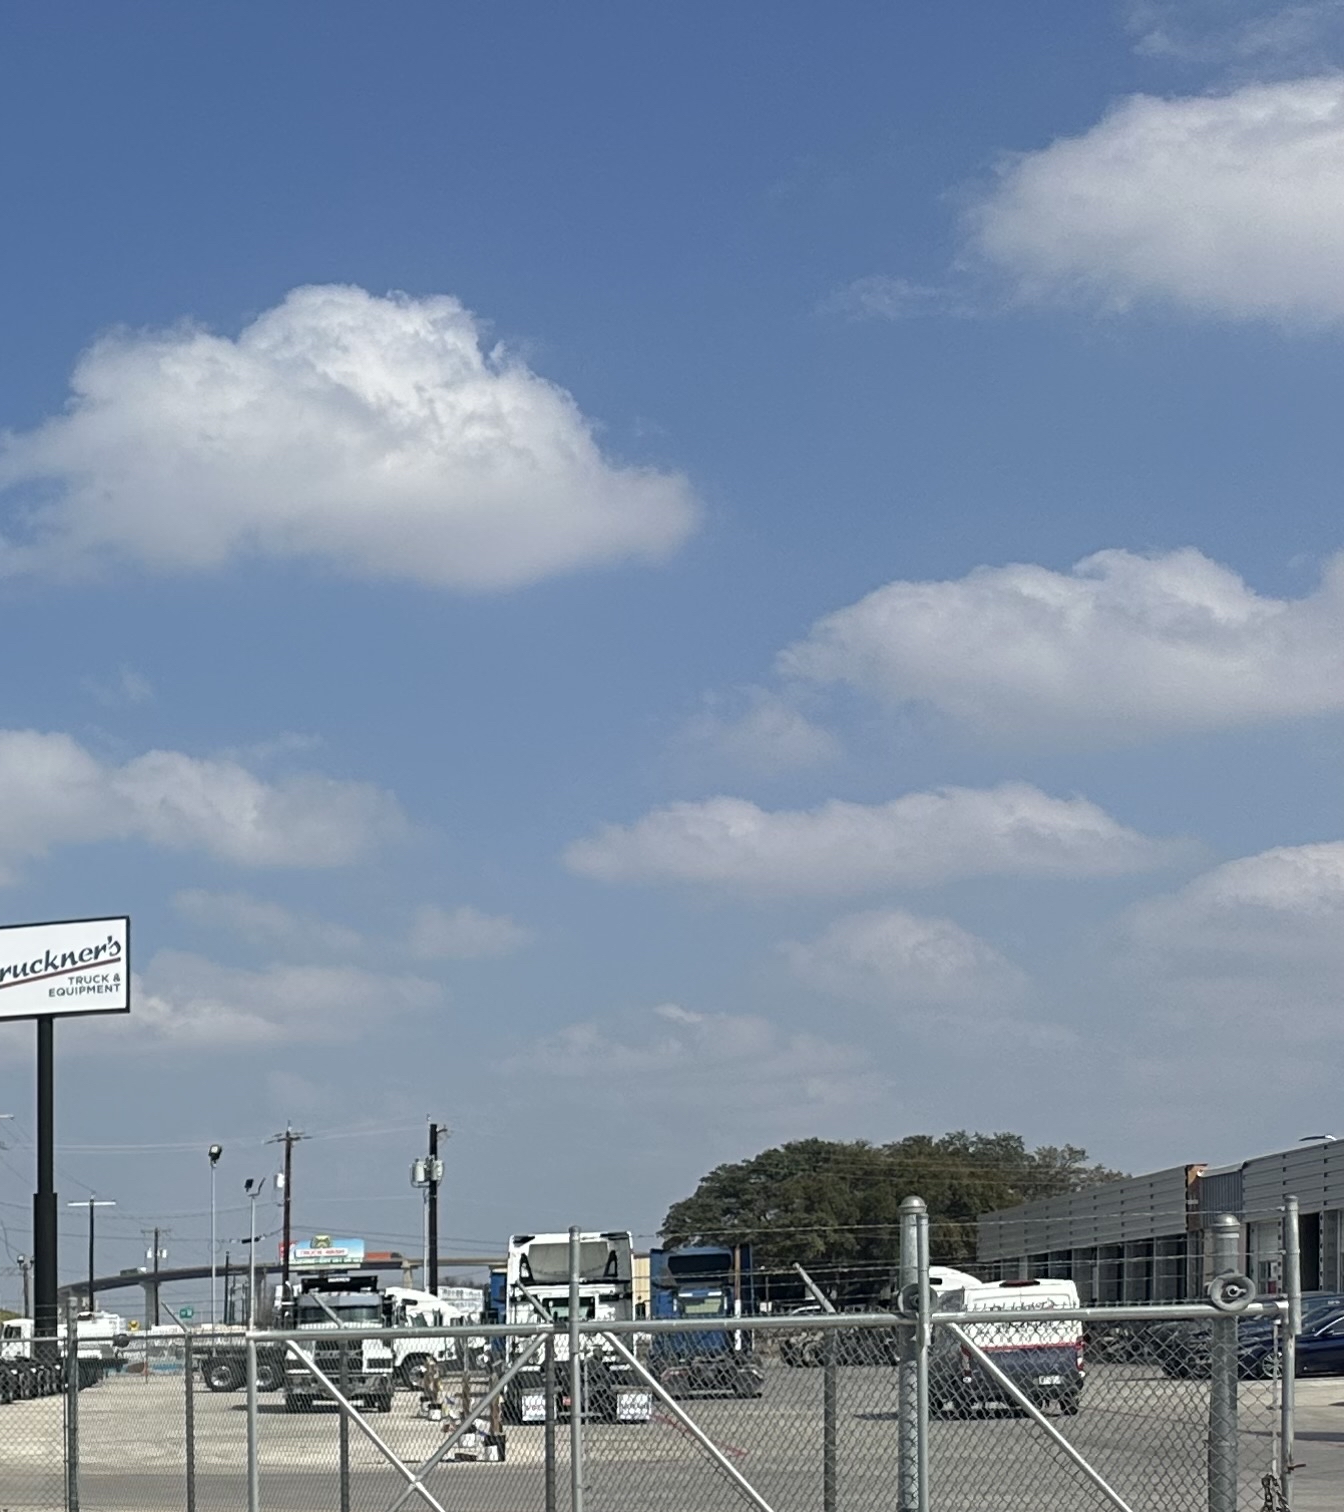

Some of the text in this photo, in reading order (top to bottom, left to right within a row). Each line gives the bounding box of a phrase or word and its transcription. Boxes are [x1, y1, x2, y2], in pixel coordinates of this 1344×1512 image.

[68, 973, 121, 986] TRUCK &
[48, 983, 121, 998] EQUIPMENT
